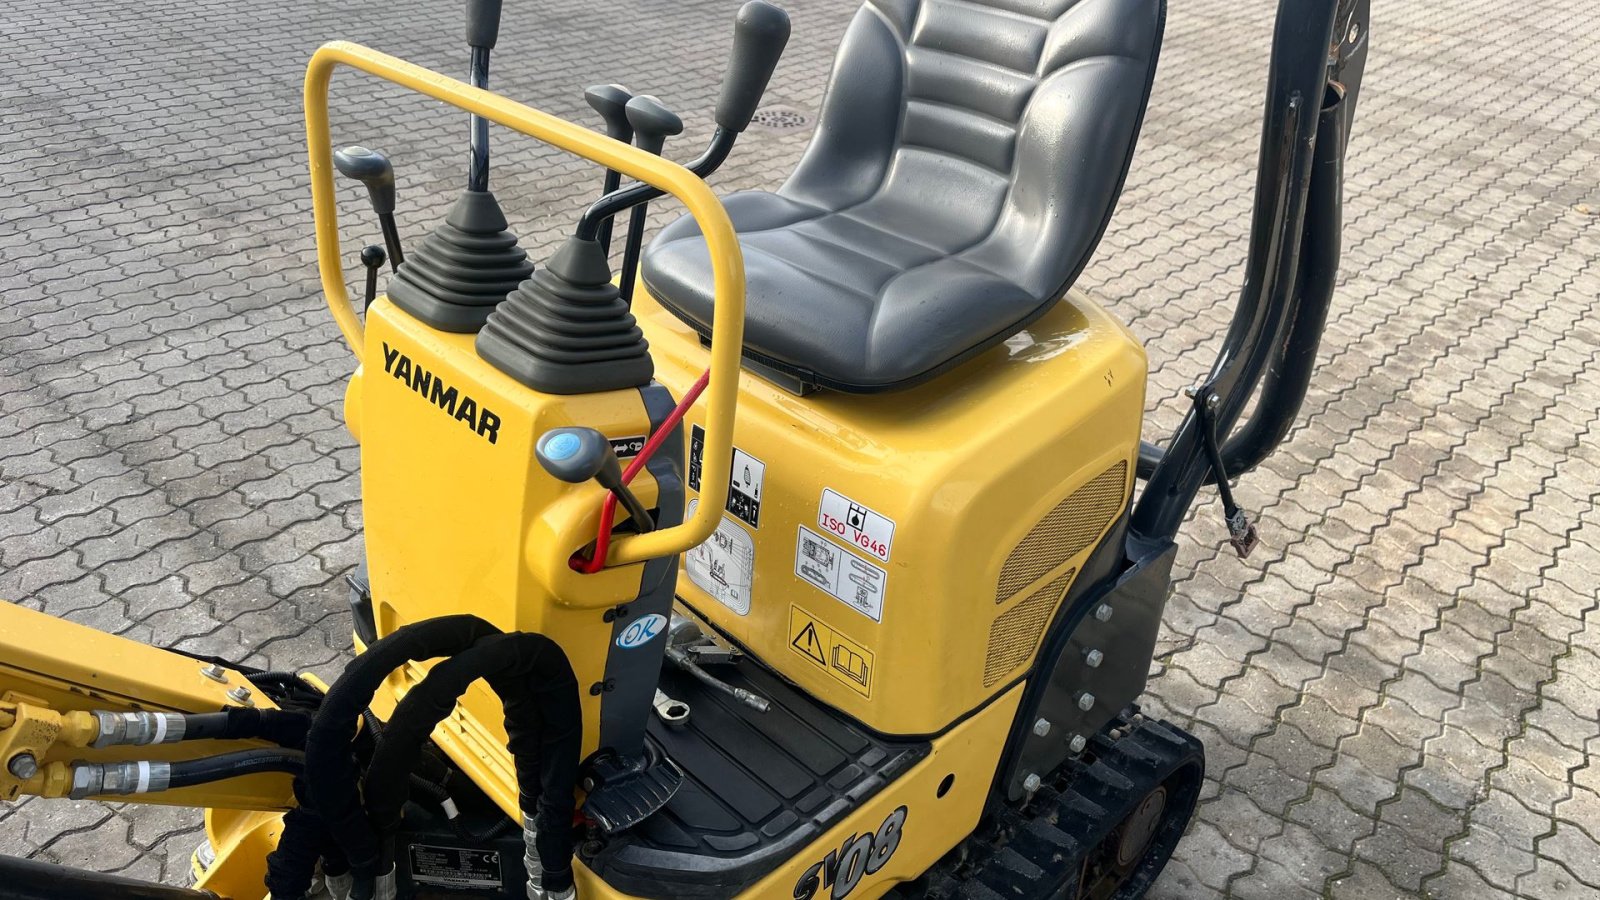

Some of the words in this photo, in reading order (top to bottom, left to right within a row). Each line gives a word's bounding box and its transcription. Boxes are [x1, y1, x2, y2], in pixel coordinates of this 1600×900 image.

[382, 341, 501, 445] YANMAR
[822, 513, 846, 535] ISO
[853, 529, 887, 557] VG46
[624, 617, 657, 645] OK
[793, 805, 908, 900] SV08
